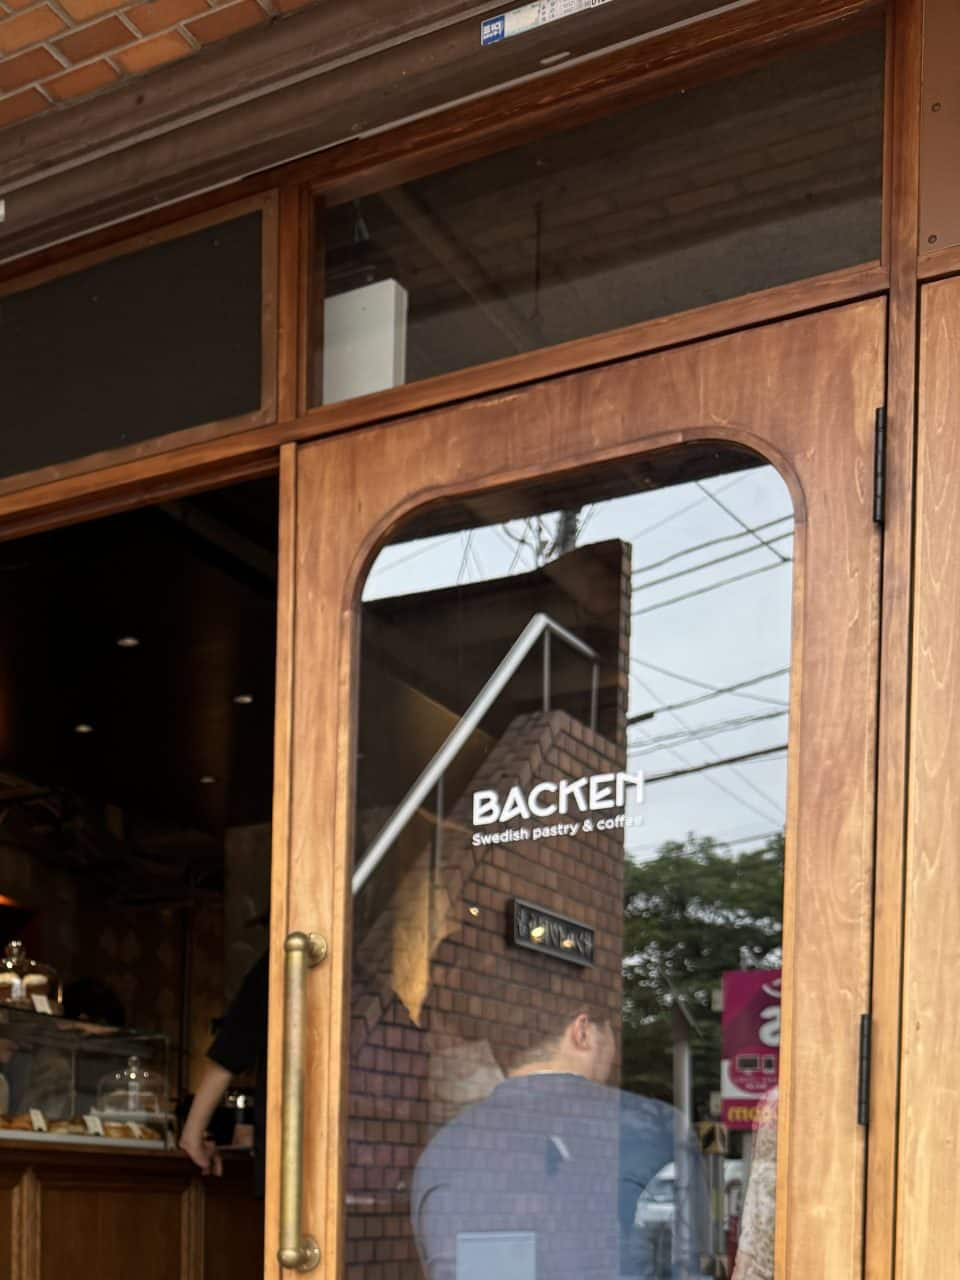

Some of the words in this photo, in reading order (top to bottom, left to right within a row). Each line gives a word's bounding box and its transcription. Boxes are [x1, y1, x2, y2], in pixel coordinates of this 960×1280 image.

[472, 770, 644, 826] BACKEN
[472, 829, 529, 846] Swedish
[533, 822, 579, 840] pastry
[583, 819, 593, 832] &
[596, 814, 644, 831] coffee
